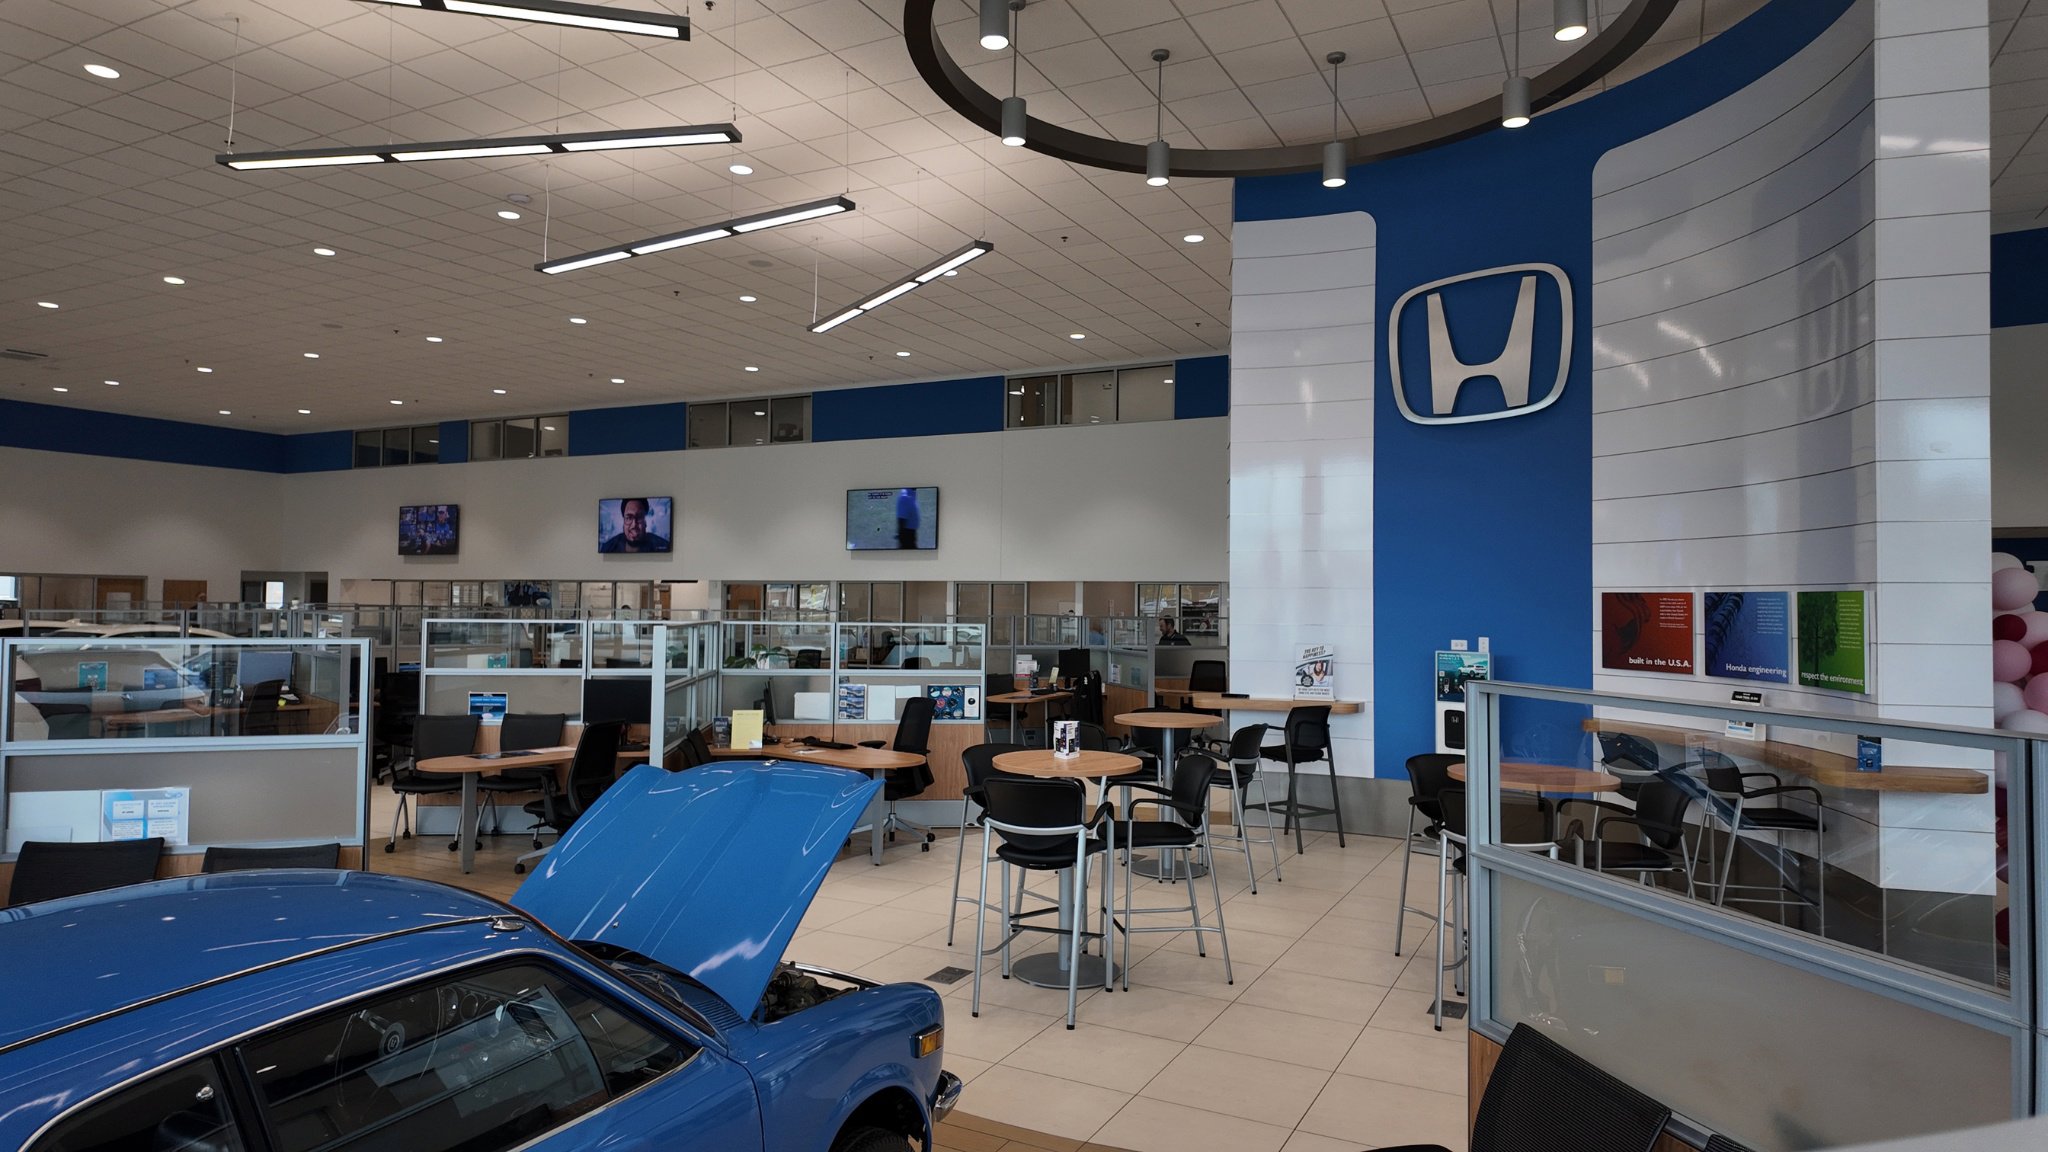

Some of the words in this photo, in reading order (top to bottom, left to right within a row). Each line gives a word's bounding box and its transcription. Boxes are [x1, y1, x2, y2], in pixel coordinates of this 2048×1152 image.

[1628, 656, 1645, 665] built
[1646, 657, 1653, 665] in
[1654, 658, 1666, 666] the
[1668, 658, 1692, 667] U.S.A.
[1725, 663, 1747, 673] Honda
[1748, 665, 1787, 678] engineering
[1801, 672, 1819, 681] respect
[1820, 673, 1829, 681] the
